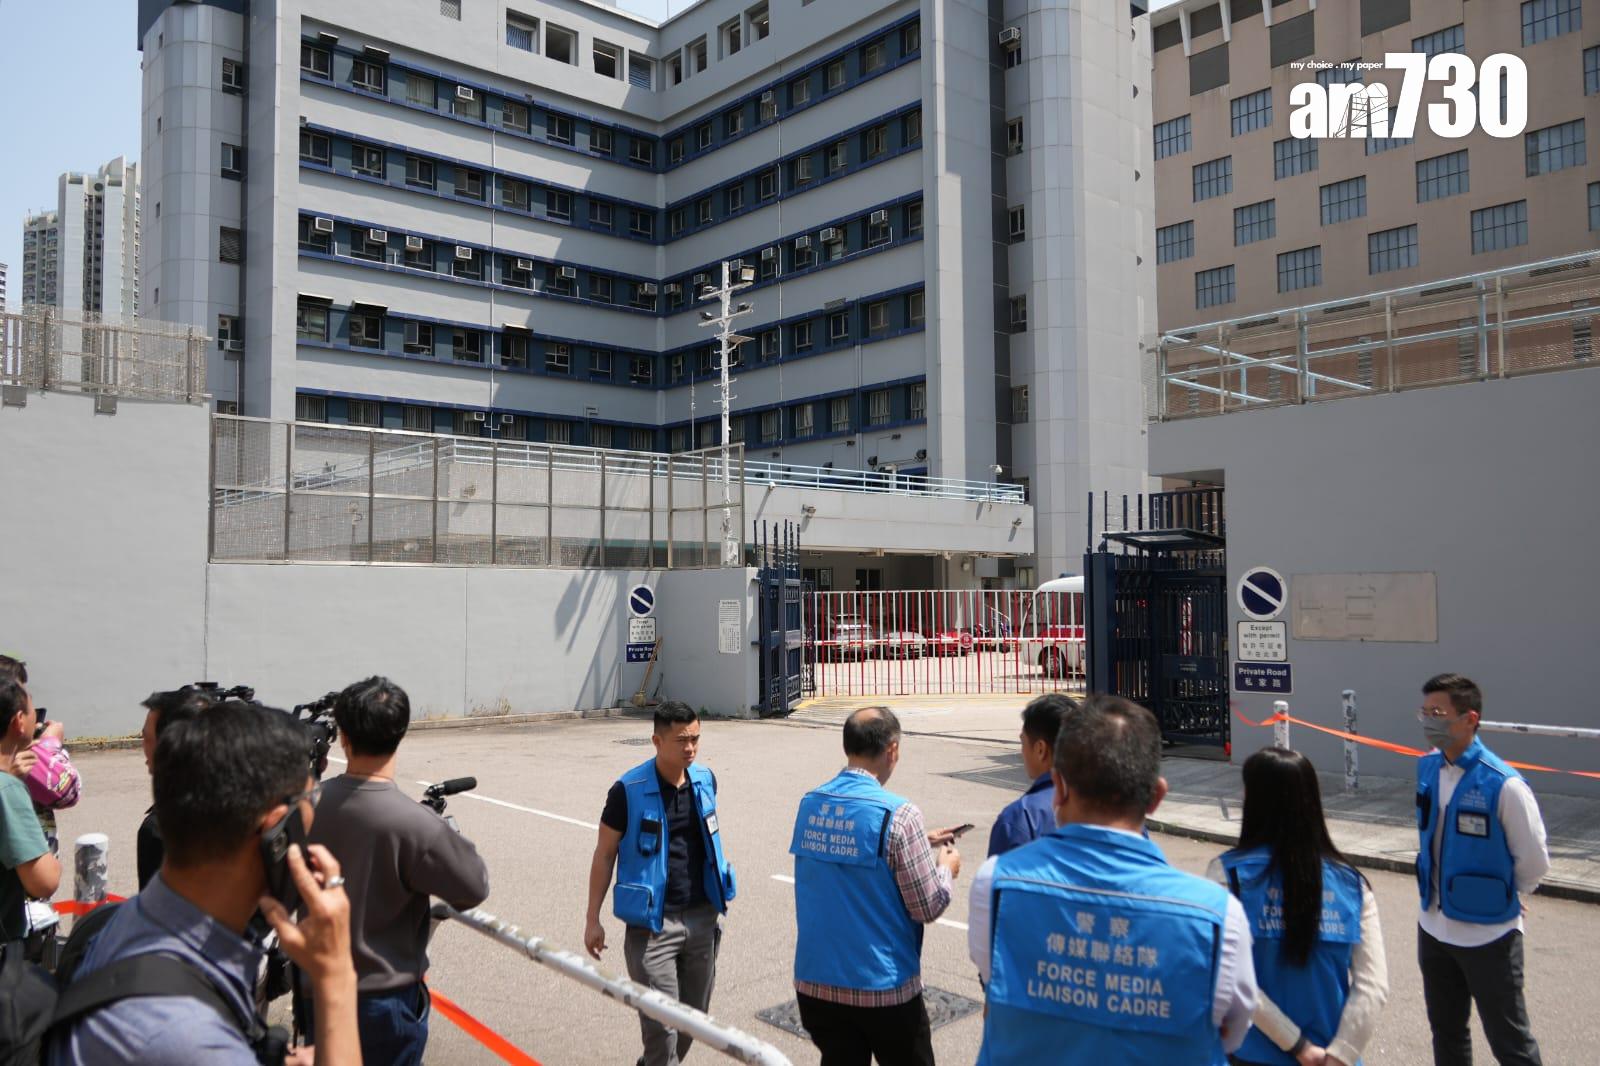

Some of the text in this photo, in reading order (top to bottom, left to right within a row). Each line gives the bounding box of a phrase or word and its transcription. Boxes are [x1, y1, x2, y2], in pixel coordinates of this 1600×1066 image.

[1238, 667, 1287, 676] Private Road
[1244, 677, 1281, 688] 私家路
[804, 830, 856, 846] FORCE MEDIA
[802, 840, 859, 857] LIAISON CADRE
[1076, 911, 1129, 938] 警察
[1037, 960, 1163, 996] FORCE MEDIA
[1027, 980, 1171, 1018] LIAISON CADRE
